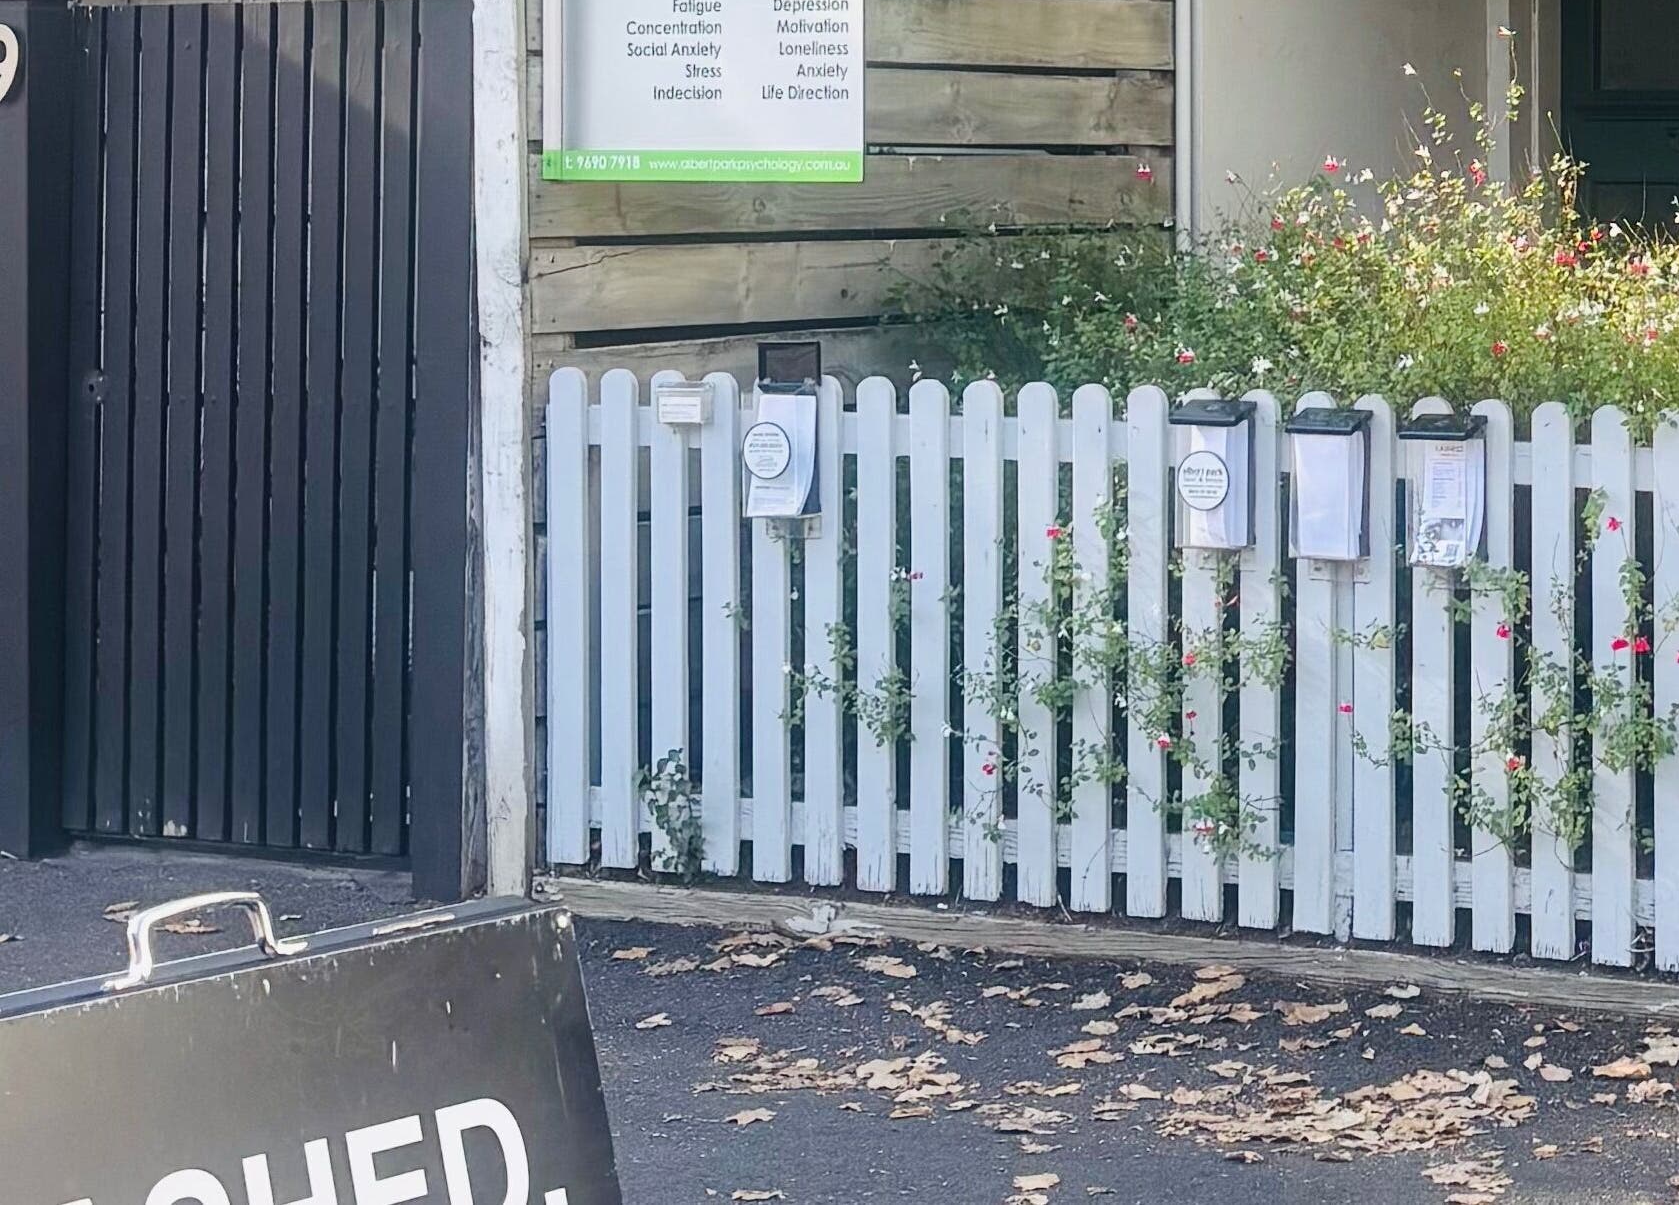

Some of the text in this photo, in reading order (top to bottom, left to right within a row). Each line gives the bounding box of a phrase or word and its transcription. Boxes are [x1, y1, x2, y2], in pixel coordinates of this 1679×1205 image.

[626, 20, 723, 36] Concentration
[776, 18, 849, 34] Motivation
[627, 41, 722, 60] Social Anxiety
[779, 40, 849, 56] Loneliness
[685, 63, 723, 78] Stress
[796, 62, 849, 81] Anxiety
[653, 85, 723, 100] Indecision
[762, 84, 849, 100] Life Direction
[576, 155, 607, 170] 9690
[609, 155, 641, 170] 7918
